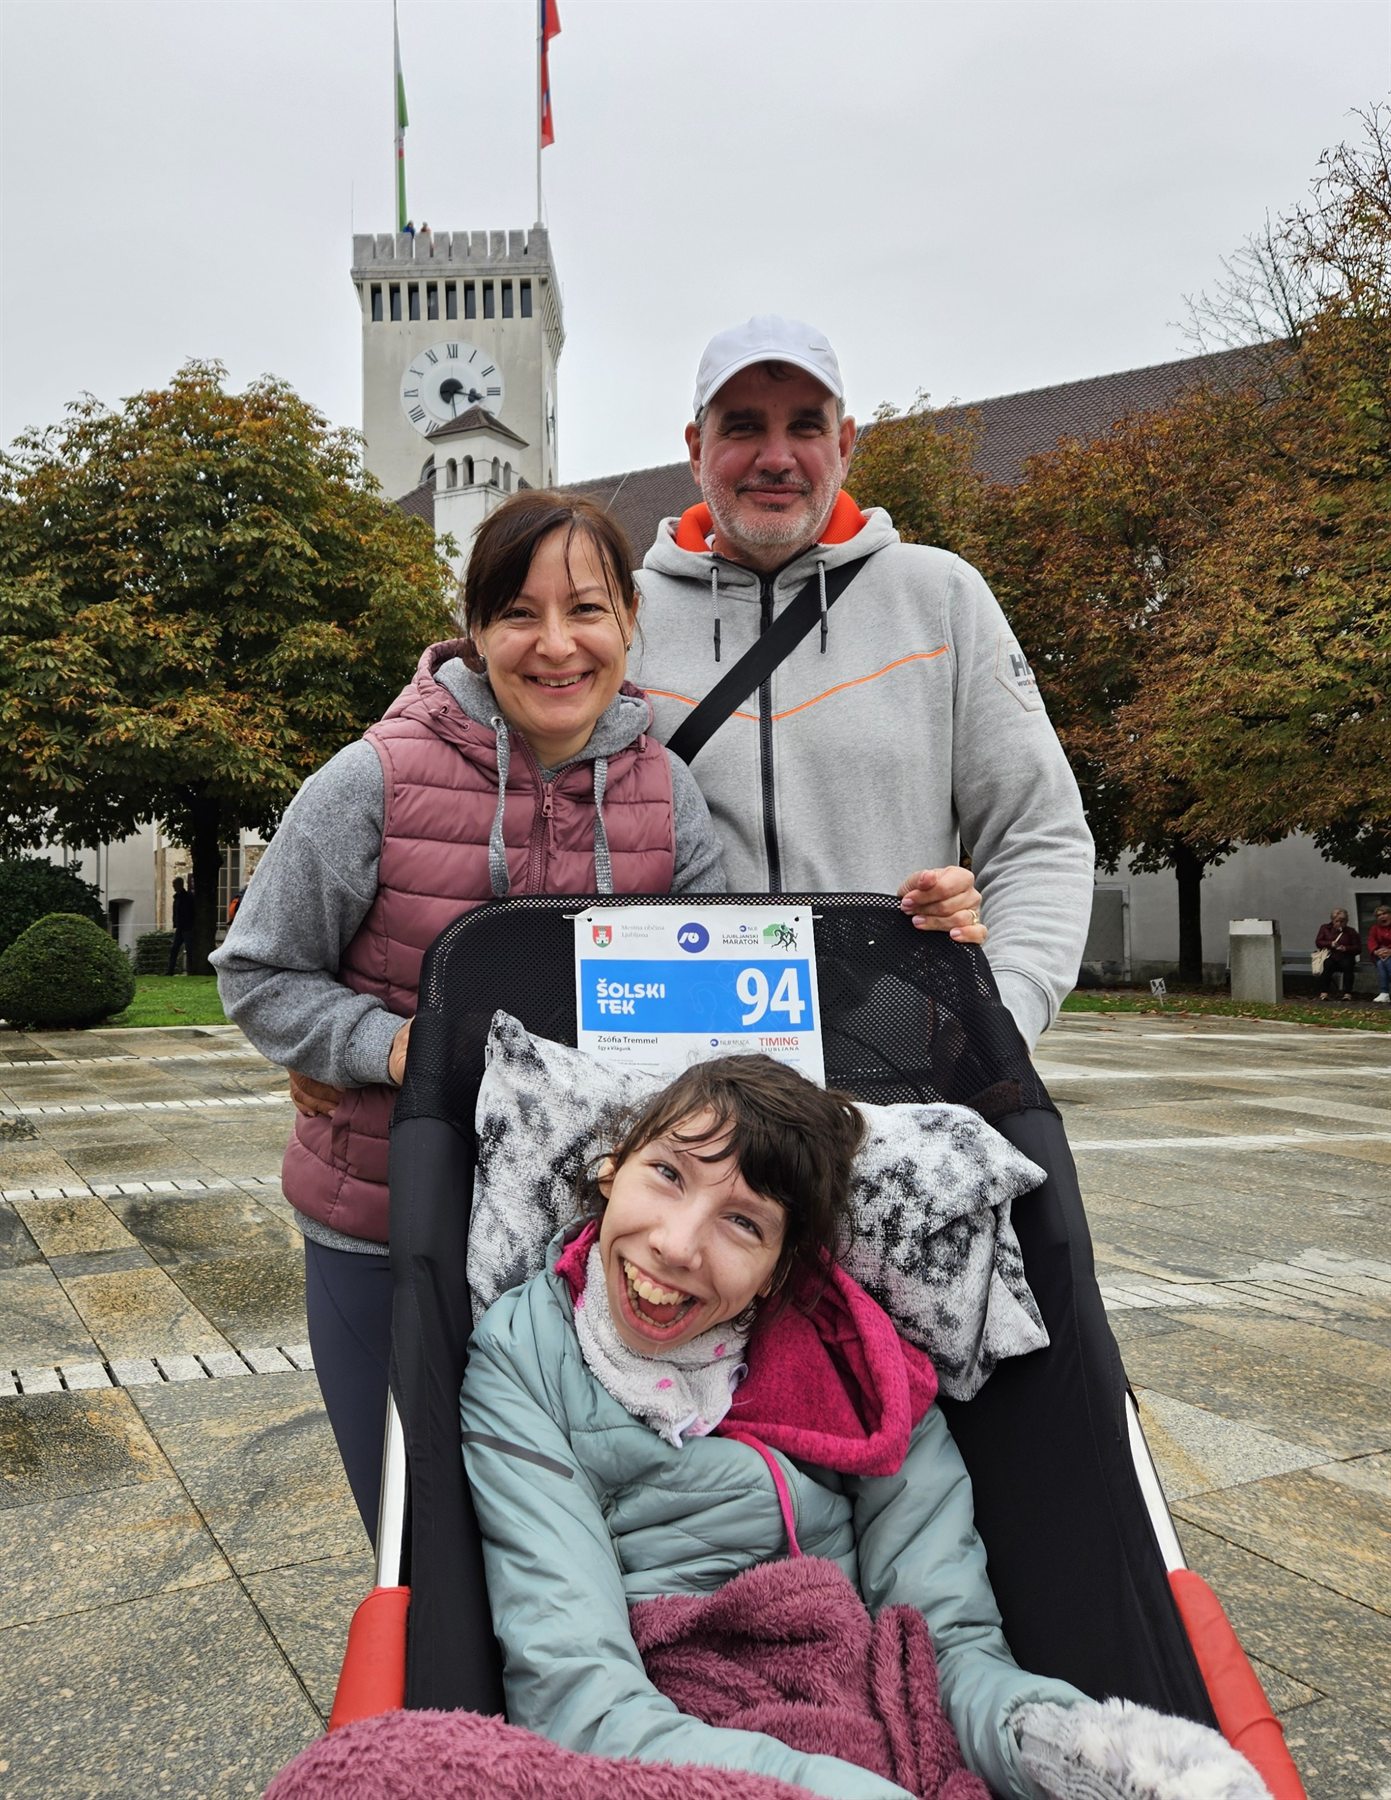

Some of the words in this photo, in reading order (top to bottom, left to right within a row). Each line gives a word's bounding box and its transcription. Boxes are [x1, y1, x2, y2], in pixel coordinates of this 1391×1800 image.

[596, 978, 666, 999] ŠOLSKI
[736, 967, 805, 1026] 94
[597, 999, 635, 1015] TEK
[597, 1035, 622, 1043] Zsófia
[623, 1036, 658, 1045] Tremmel
[758, 1036, 799, 1046] TIMING
